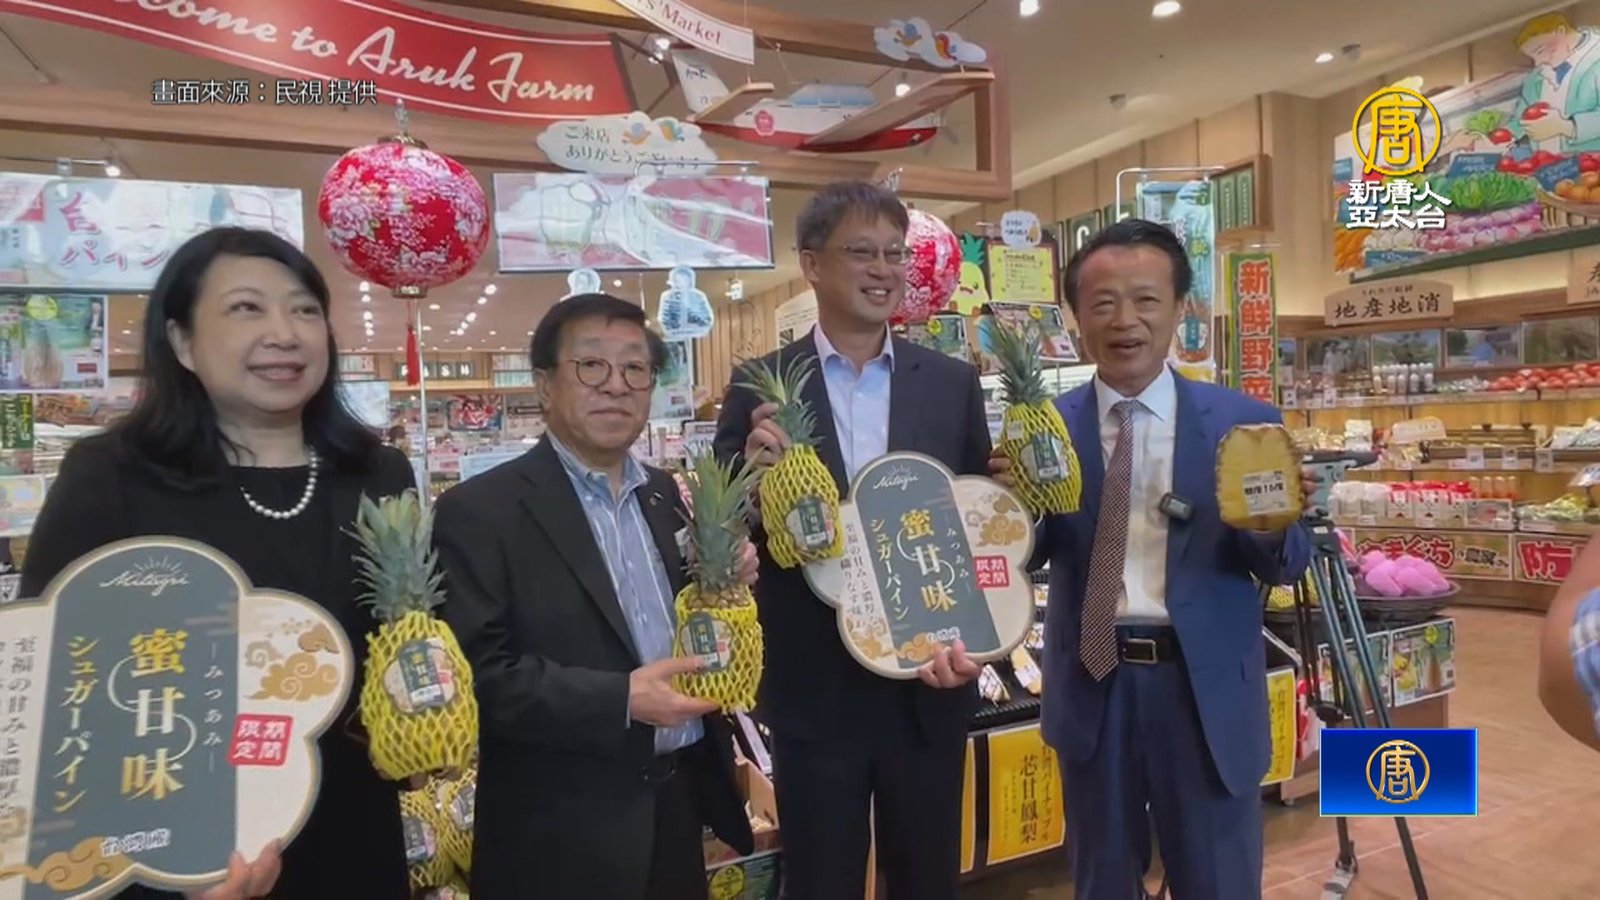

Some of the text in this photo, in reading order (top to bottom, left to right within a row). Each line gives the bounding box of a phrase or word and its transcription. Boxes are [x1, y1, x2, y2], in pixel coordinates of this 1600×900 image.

[291, 26, 338, 57] to
[347, 27, 475, 90] Aruk
[487, 53, 594, 102] Farm
[1335, 292, 1441, 318] 地産地消
[870, 518, 909, 621] シュガーパイン
[900, 508, 957, 614] 蜜甘味
[53, 636, 100, 813] シュガーパイン
[121, 628, 189, 801] 蜜甘味
